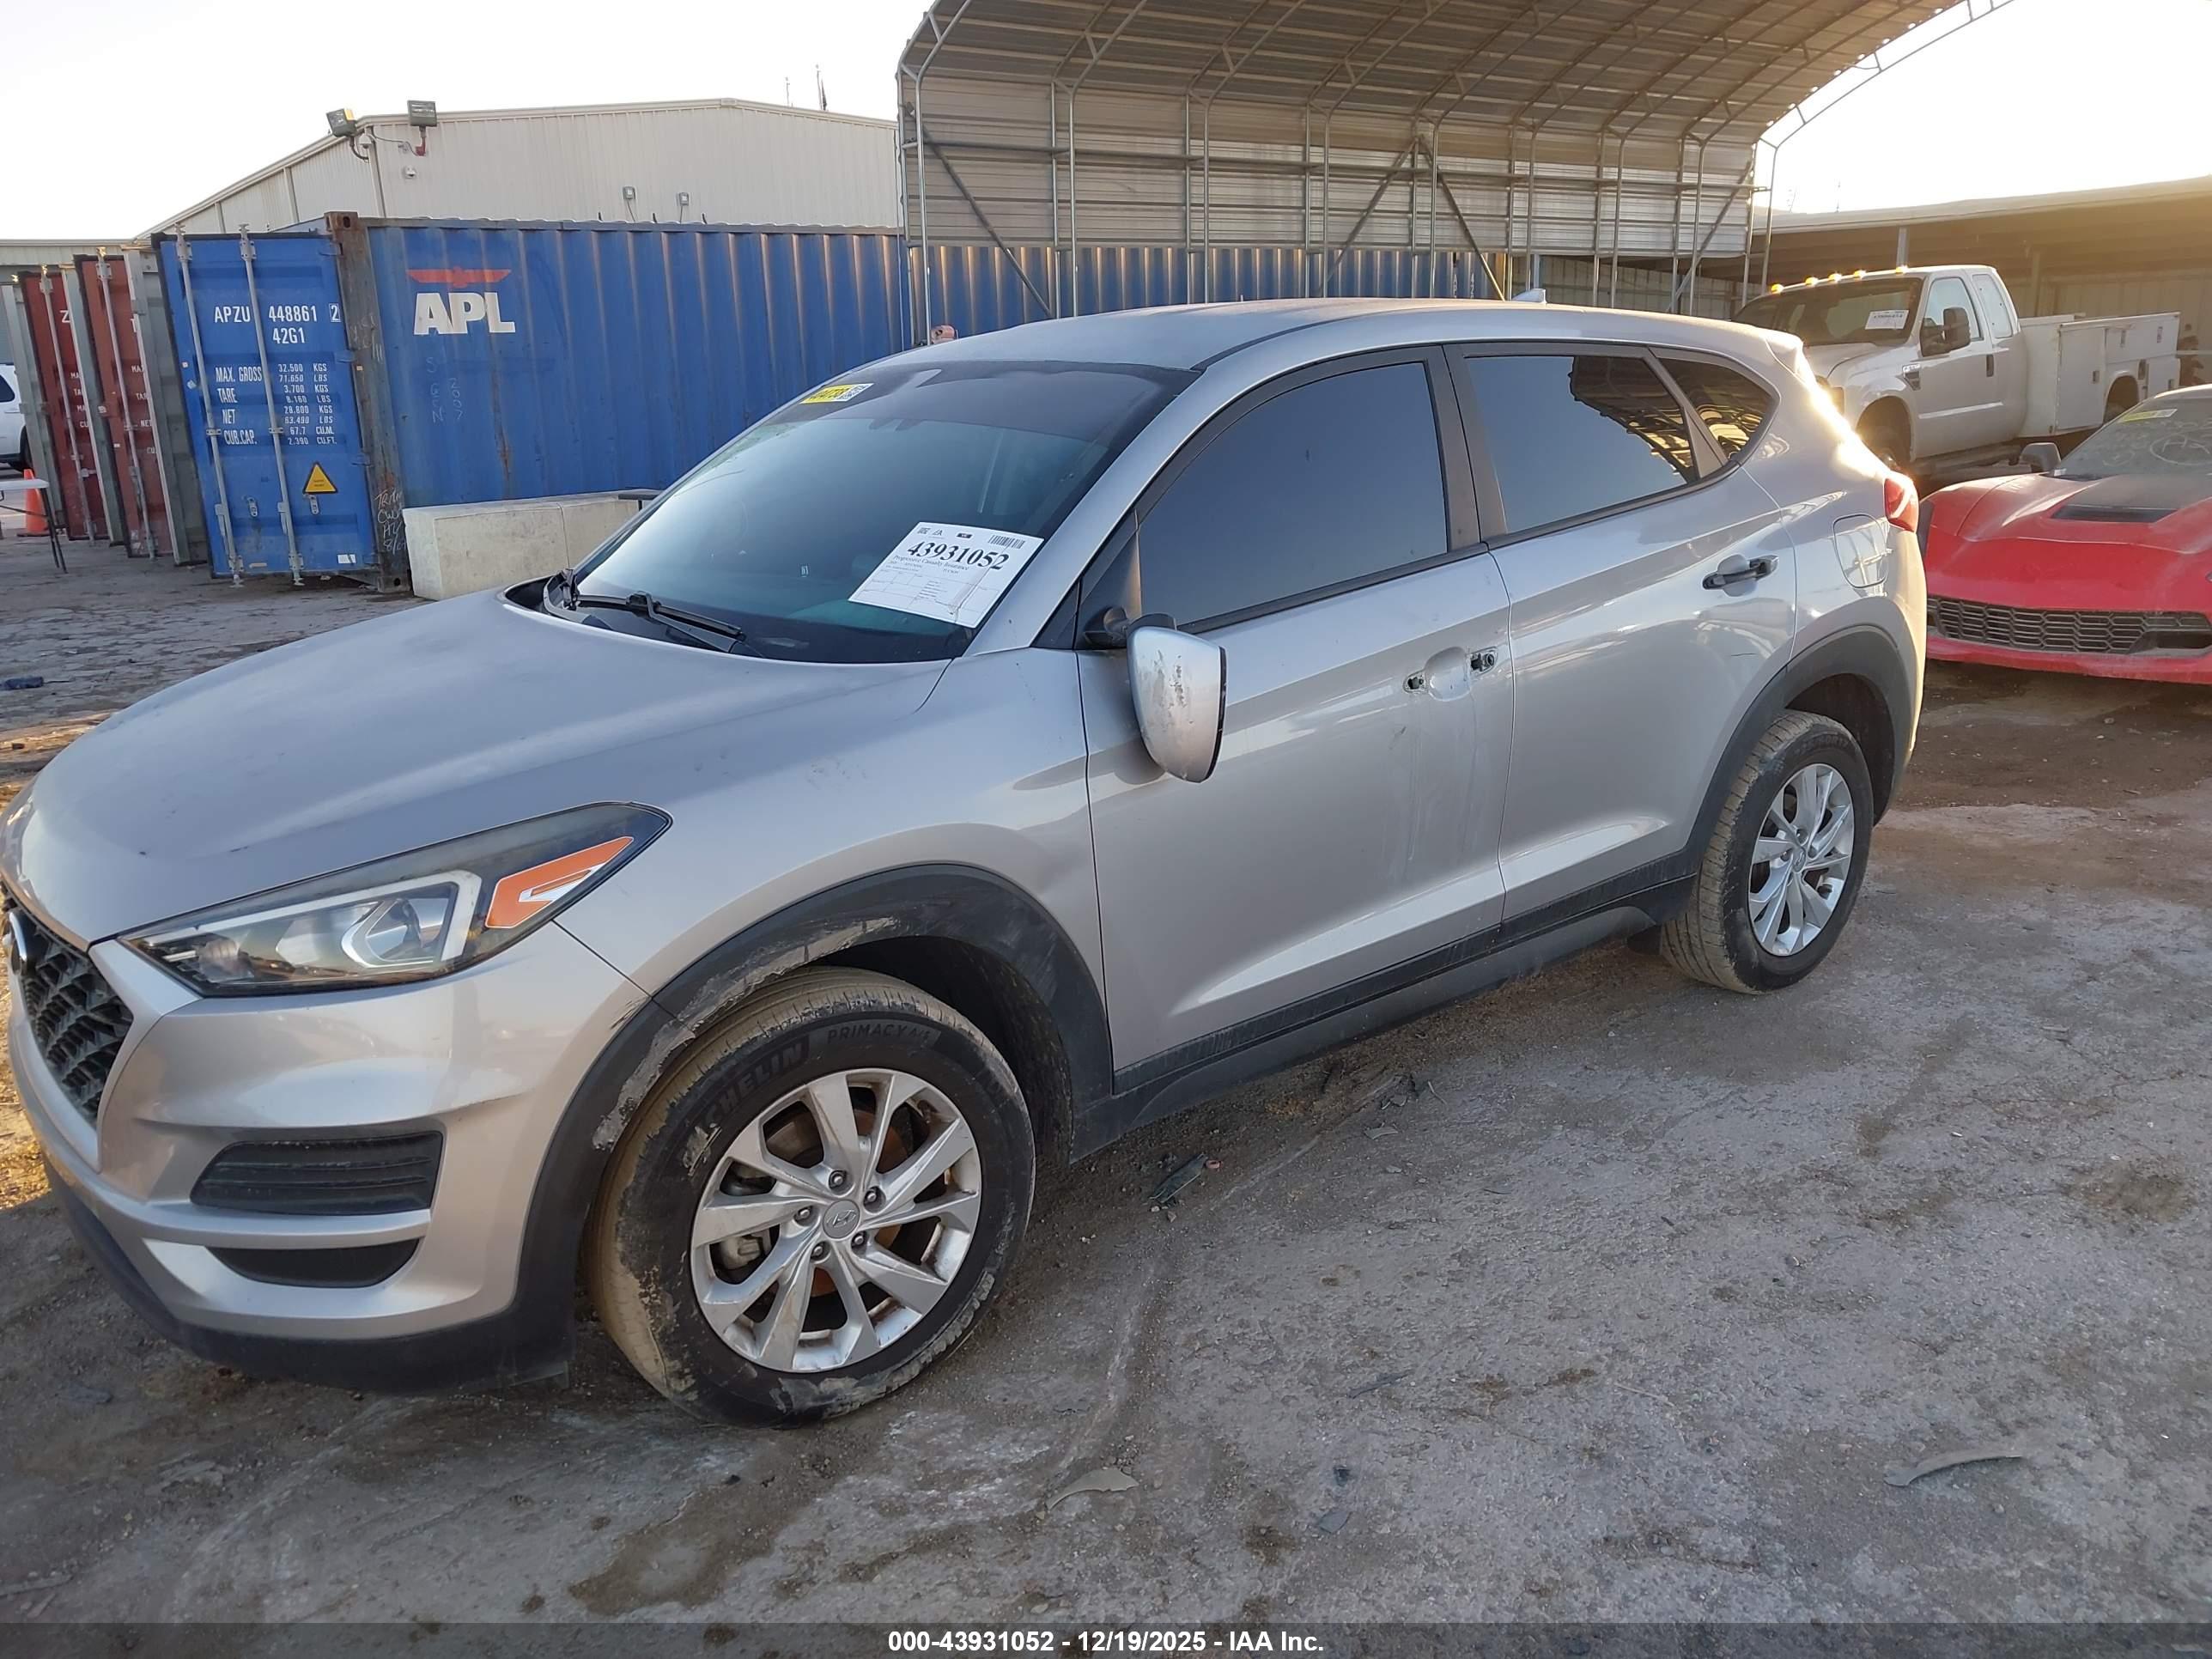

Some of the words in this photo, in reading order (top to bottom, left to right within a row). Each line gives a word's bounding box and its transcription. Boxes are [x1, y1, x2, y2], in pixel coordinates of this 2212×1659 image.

[215, 306, 251, 323] APZU
[269, 305, 317, 322] 448861
[330, 303, 341, 322] 2
[414, 292, 515, 335] APL
[273, 327, 305, 344] 42G1
[216, 367, 236, 383] MAX.
[239, 366, 263, 382] GROSS
[277, 363, 304, 372] 32.500
[313, 362, 327, 372] KGS
[313, 374, 328, 382] LBS
[217, 387, 238, 404] TARE
[314, 384, 329, 392] KGS
[222, 408, 236, 425] NET
[319, 404, 333, 414] KGS
[319, 416, 333, 424] LBS
[907, 541, 1010, 570] 43931052
[828, 1023, 908, 1043] PRIMACY
